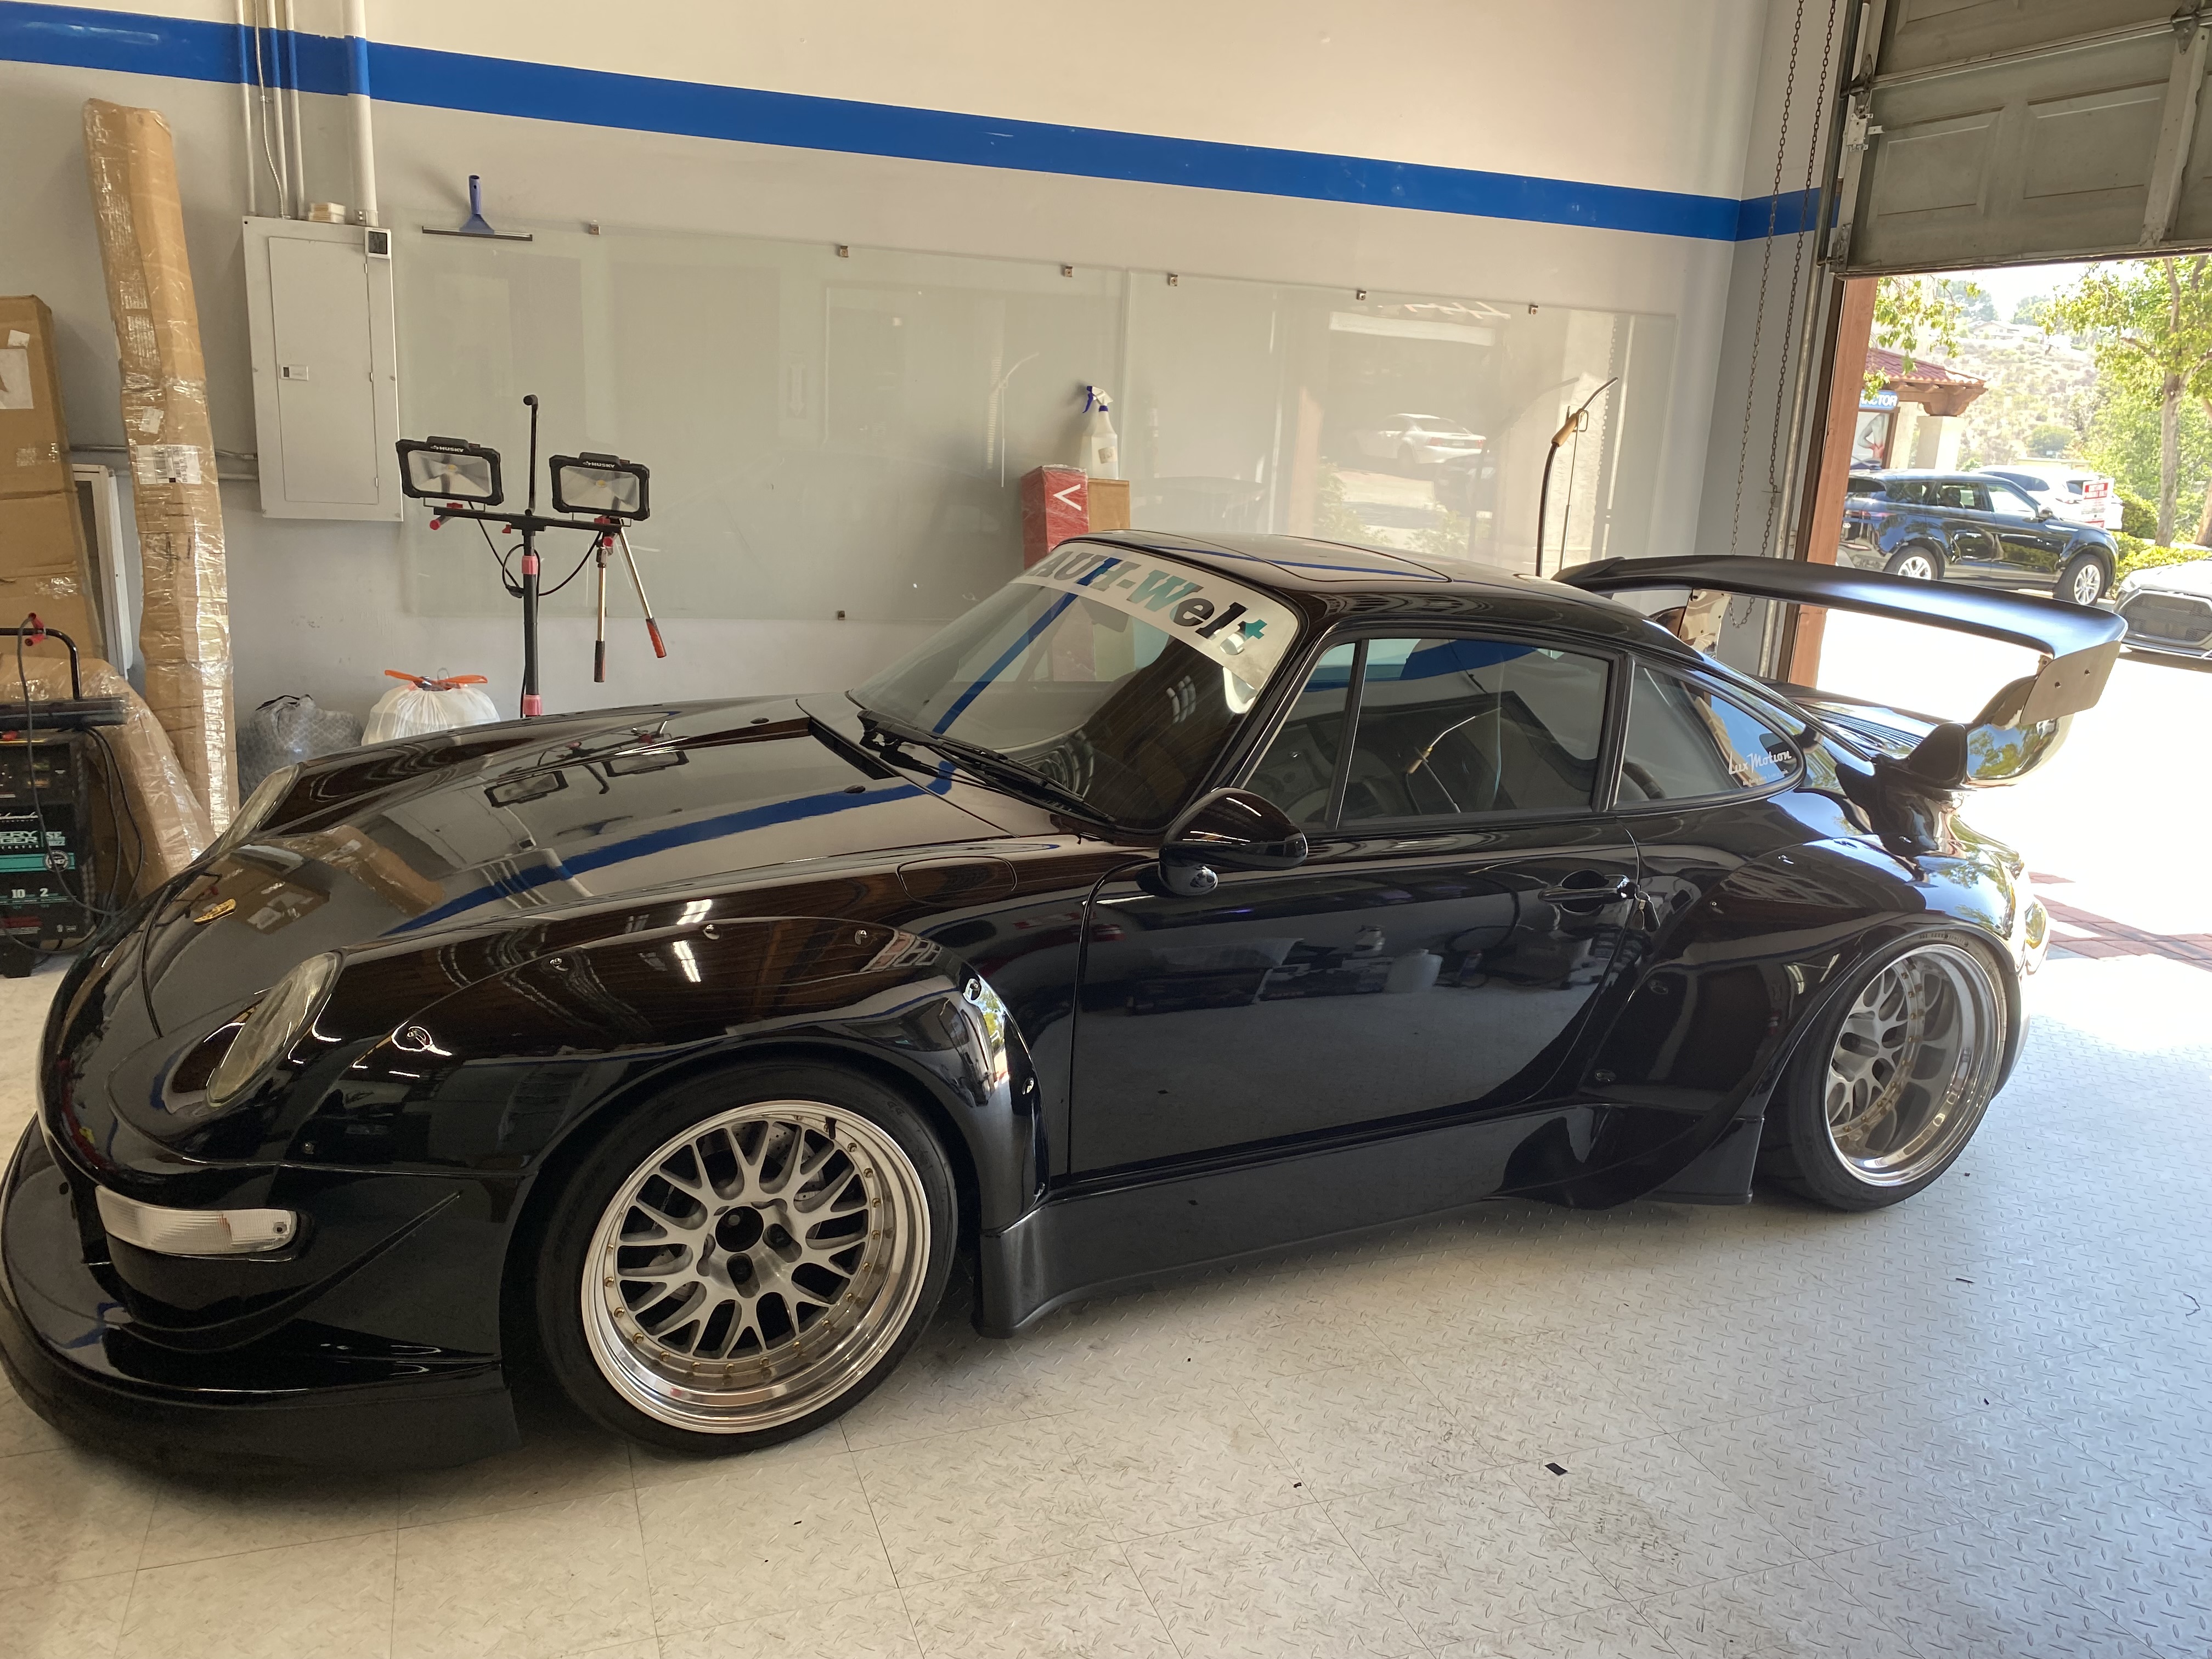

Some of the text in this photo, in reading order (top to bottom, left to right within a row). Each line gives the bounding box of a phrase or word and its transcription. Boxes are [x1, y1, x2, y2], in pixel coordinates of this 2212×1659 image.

[1729, 751, 1792, 775] Lux Motion
[40, 888, 49, 897] 2
